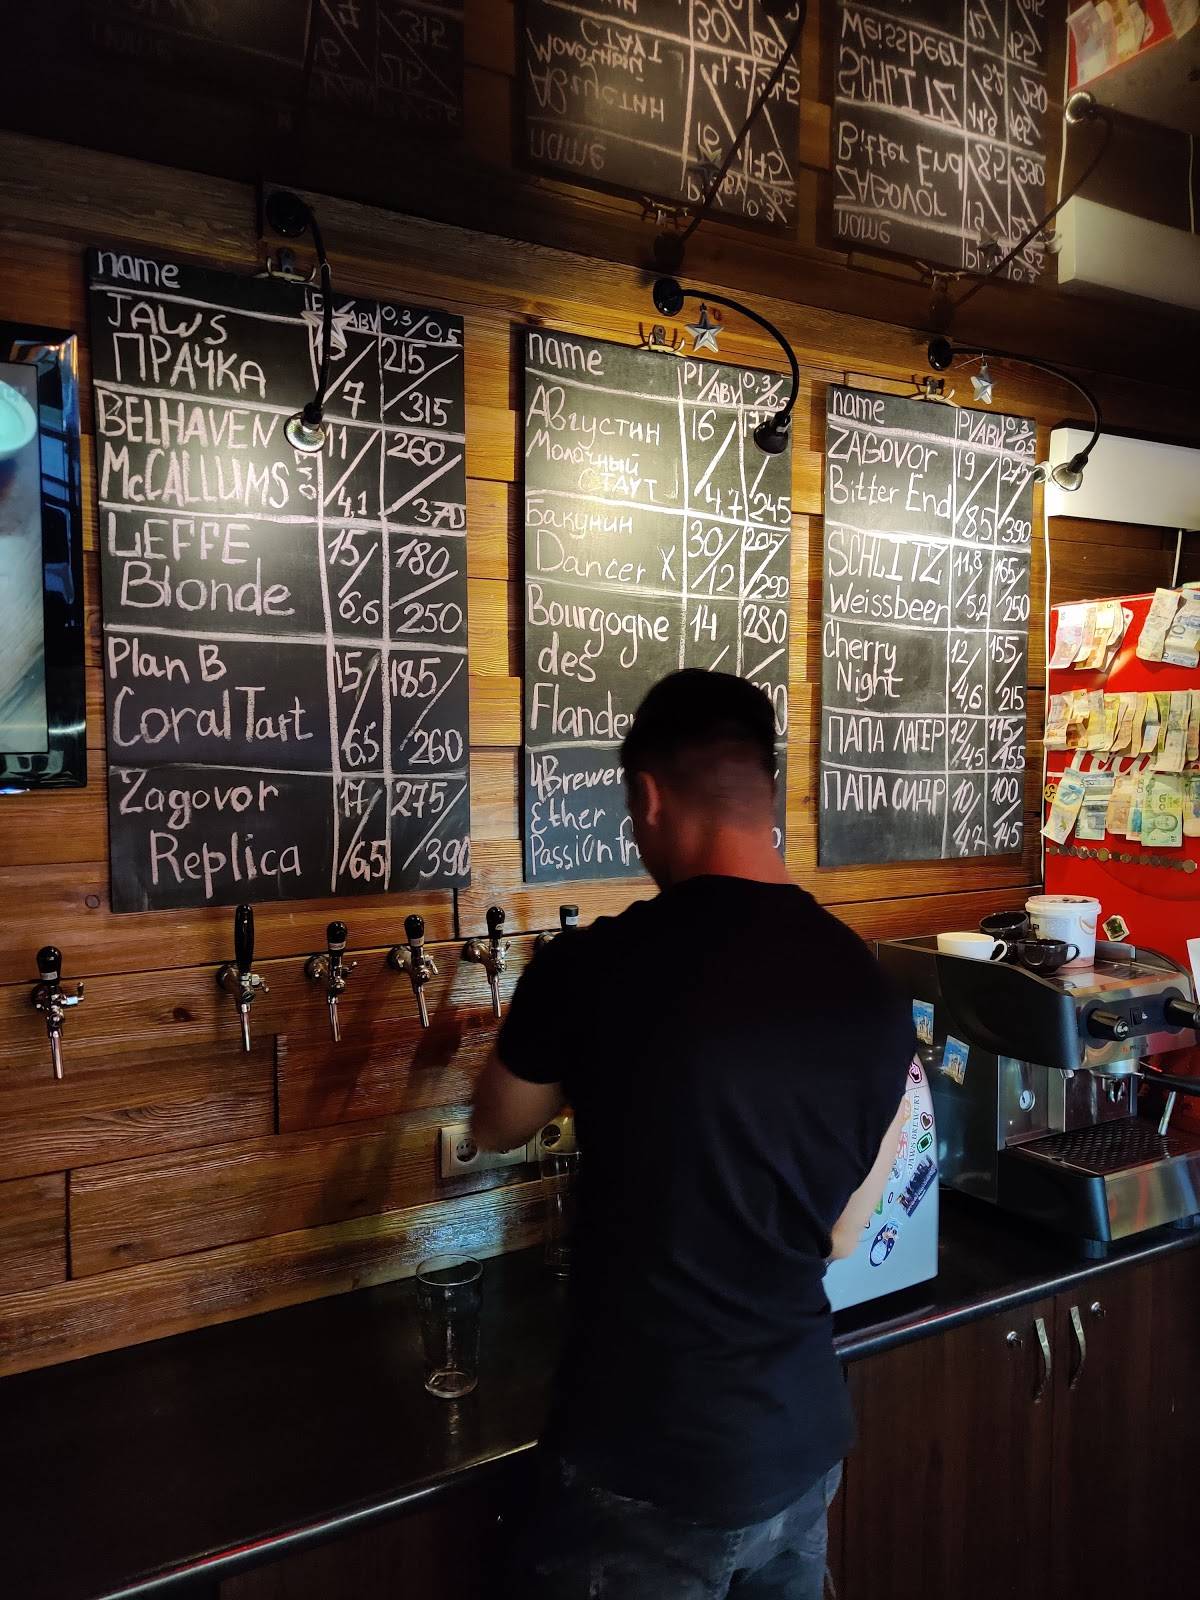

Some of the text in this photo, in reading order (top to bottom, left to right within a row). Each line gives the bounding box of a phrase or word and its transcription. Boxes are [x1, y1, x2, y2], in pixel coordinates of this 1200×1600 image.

[98, 251, 181, 288] name
[106, 293, 227, 345] JAWS
[113, 333, 266, 398] ПРАЧКА
[528, 333, 604, 375] name
[98, 388, 280, 449] BELHAVEN
[343, 380, 366, 420] 7
[402, 391, 453, 426] 315
[833, 390, 885, 424] name
[693, 409, 717, 441] 16
[387, 432, 445, 466] 260
[749, 493, 791, 523] 245
[830, 464, 952, 520] Bitter End
[108, 512, 250, 564] LEFFE
[525, 499, 633, 538] Бакунин
[1002, 517, 1031, 544] 390
[536, 529, 646, 583] Dancer
[828, 528, 950, 585] SCHLITZ
[121, 558, 296, 617] Blonde
[830, 582, 950, 624] Weissbeer
[1003, 595, 1030, 622] 250
[396, 602, 462, 633] 250
[528, 584, 670, 668] Bourgogne
[690, 604, 717, 642] 14
[743, 604, 787, 644] 280
[107, 636, 227, 685] Plan B
[538, 632, 597, 682] des
[823, 620, 897, 673] Cherry
[837, 661, 903, 702] Night
[112, 686, 314, 748] Coral Tart
[828, 716, 945, 755] ПАПА ЛАГЕР
[408, 729, 463, 765] 260
[119, 769, 280, 830] Zagovor
[824, 771, 945, 816] ПАПА СИДР
[150, 830, 302, 899] Replica
[420, 836, 471, 878] 390
[530, 833, 613, 875] Passion
